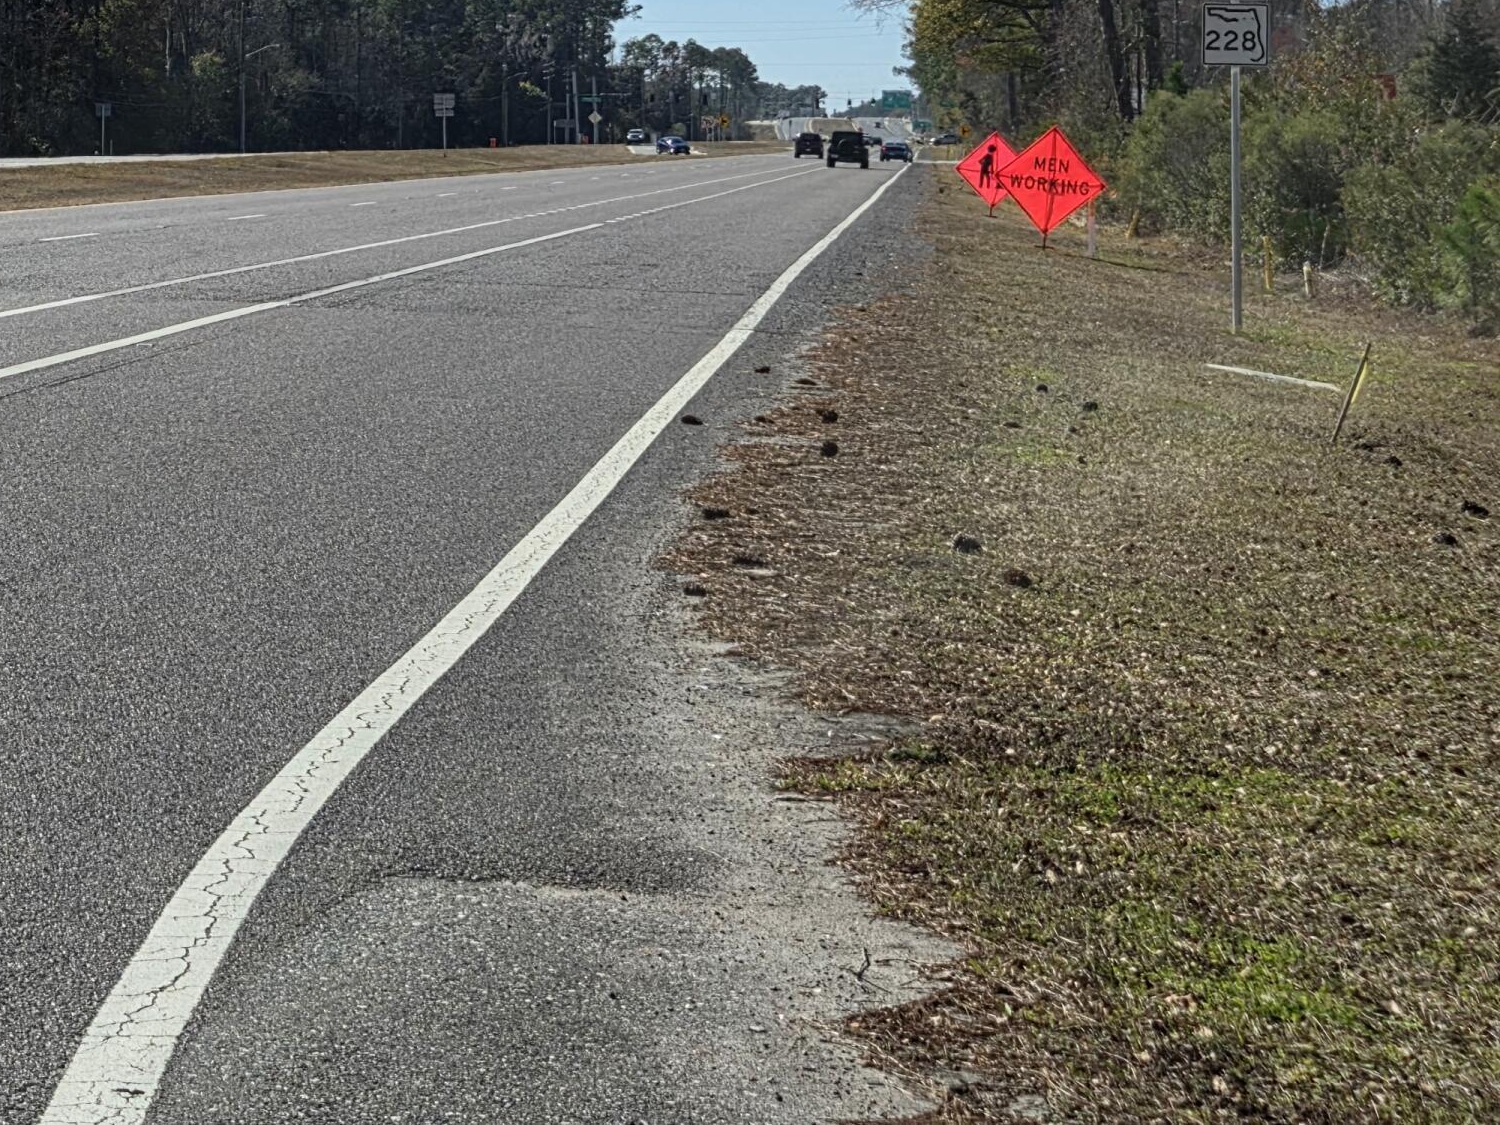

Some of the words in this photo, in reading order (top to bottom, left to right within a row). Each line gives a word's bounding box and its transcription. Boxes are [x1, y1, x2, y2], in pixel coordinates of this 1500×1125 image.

[1205, 30, 1257, 51] 228
[1033, 156, 1070, 174] MEN
[1010, 173, 1090, 196] WORKING
